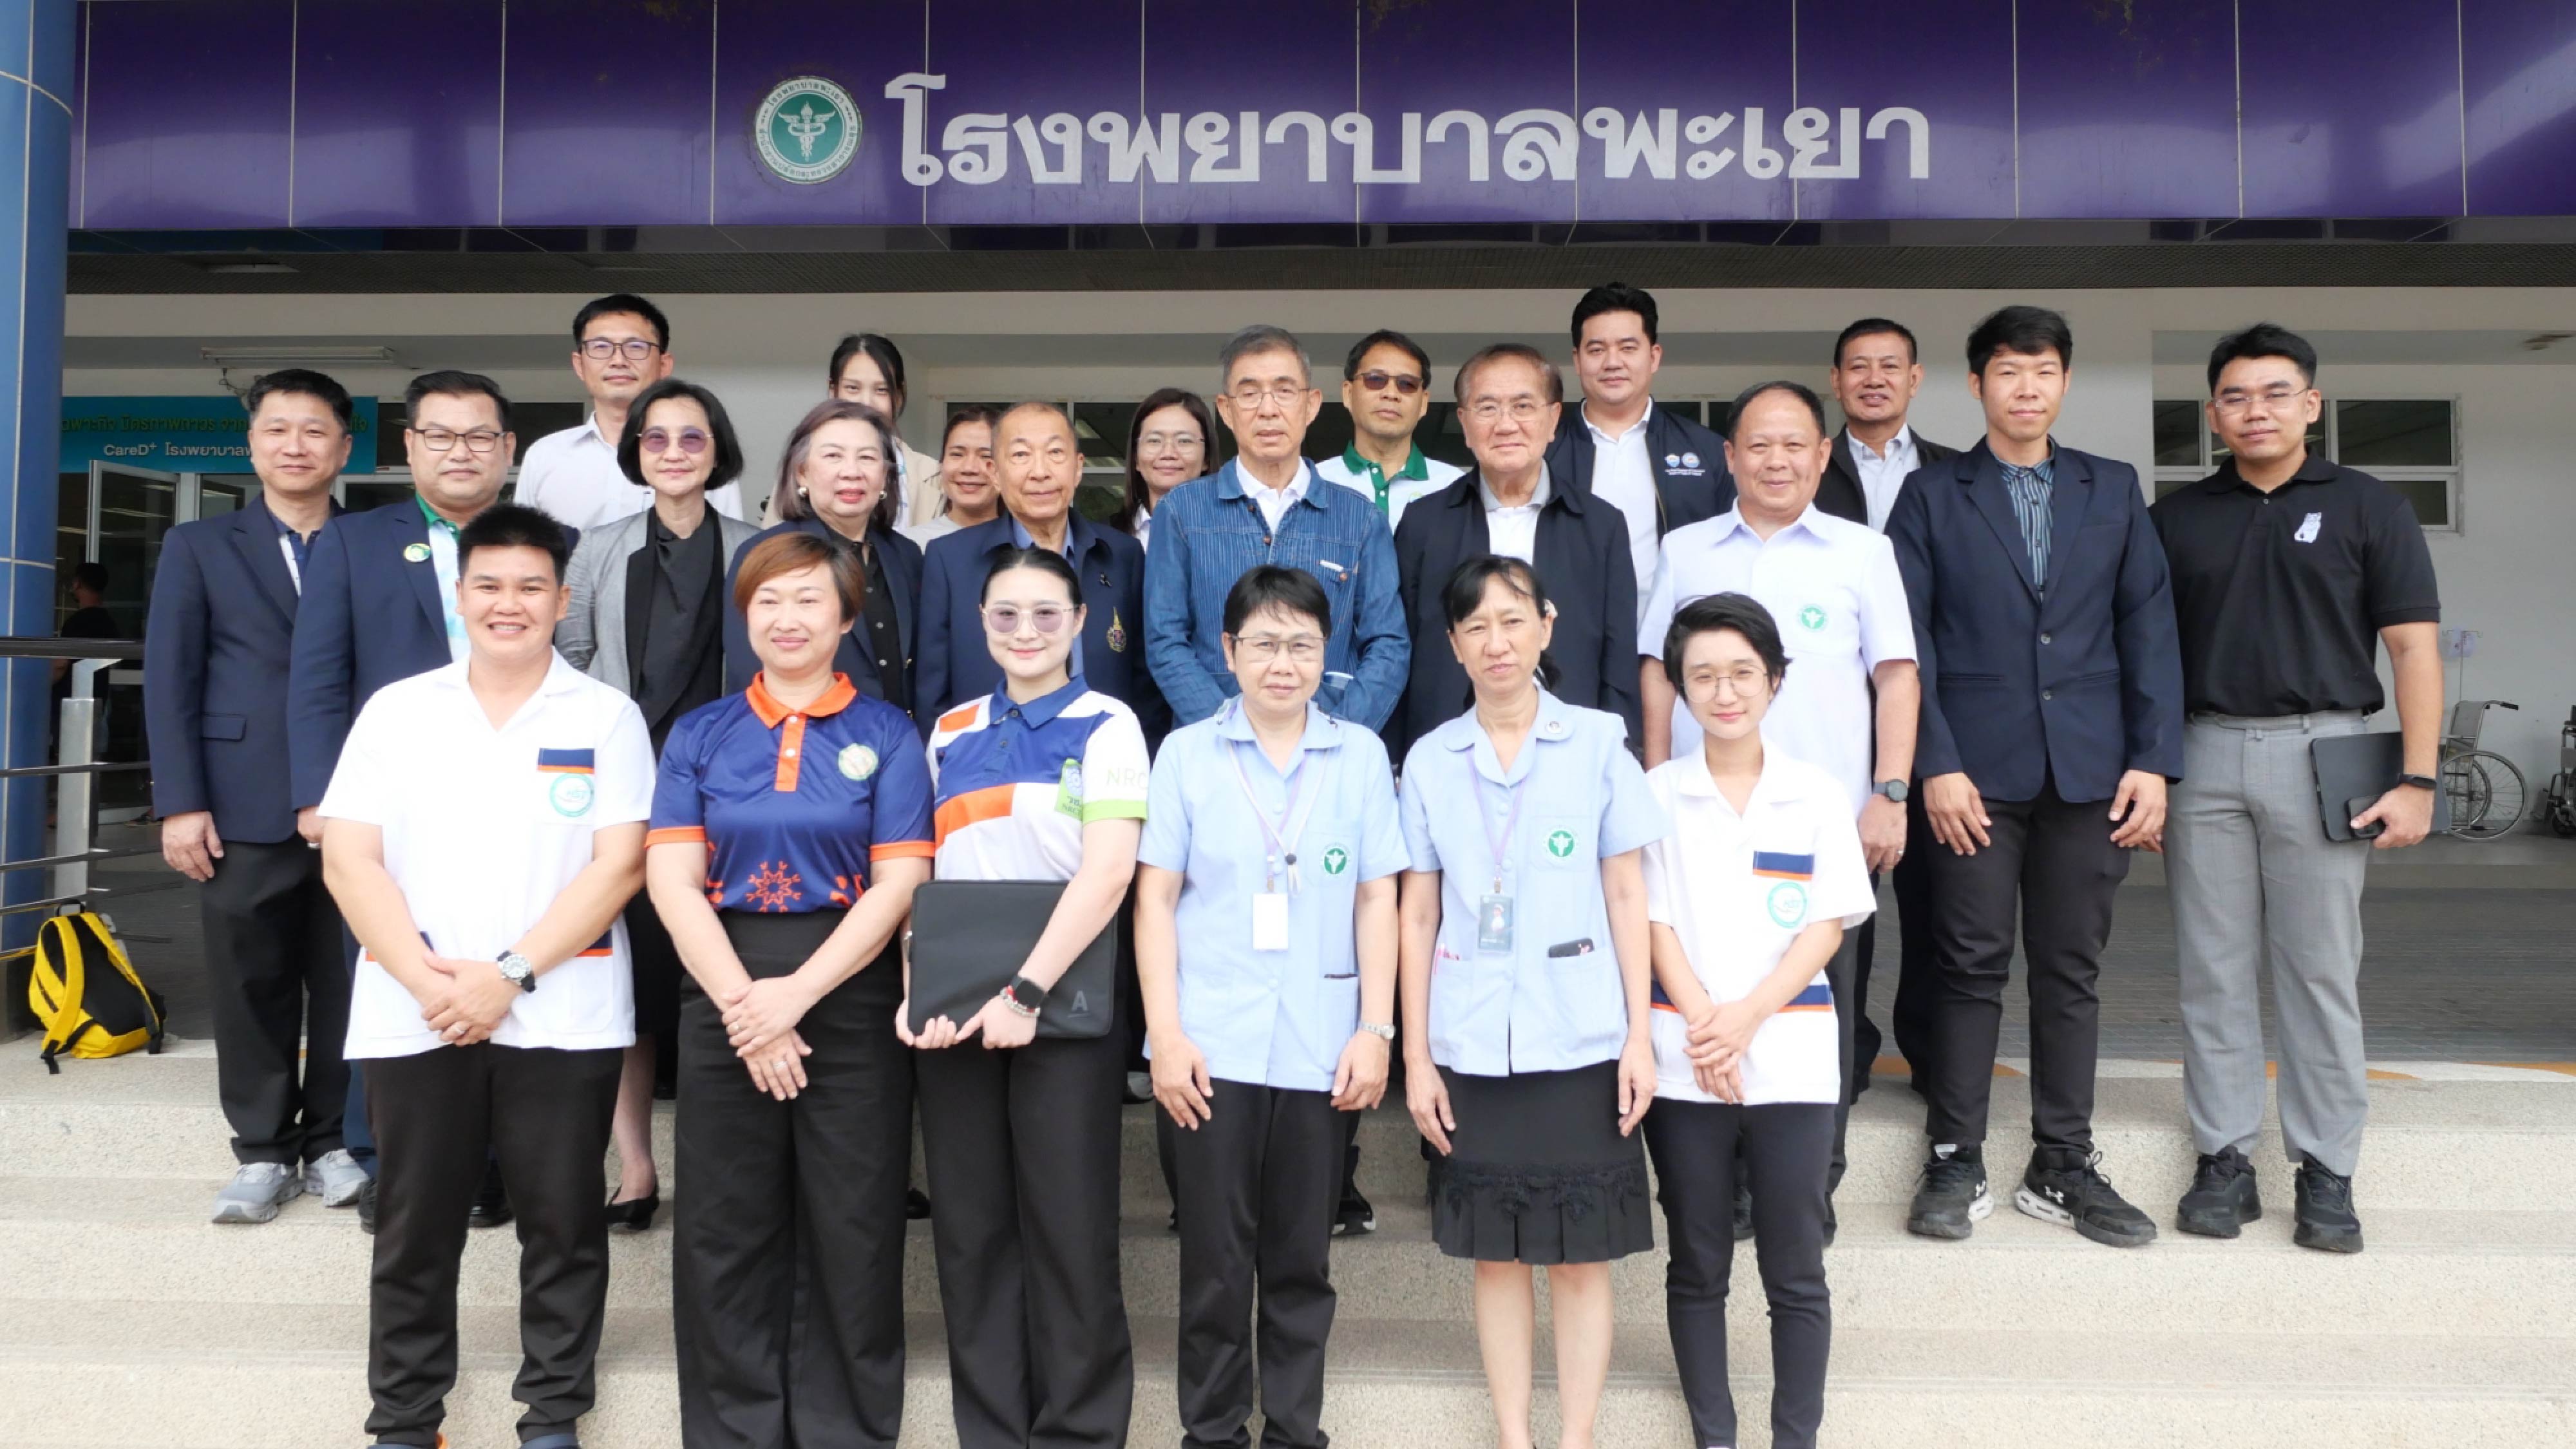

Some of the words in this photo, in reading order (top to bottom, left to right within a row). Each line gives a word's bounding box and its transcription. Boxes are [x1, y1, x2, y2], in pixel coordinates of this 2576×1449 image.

[885, 73, 1931, 185] โรงพยาบาลพะเยา
